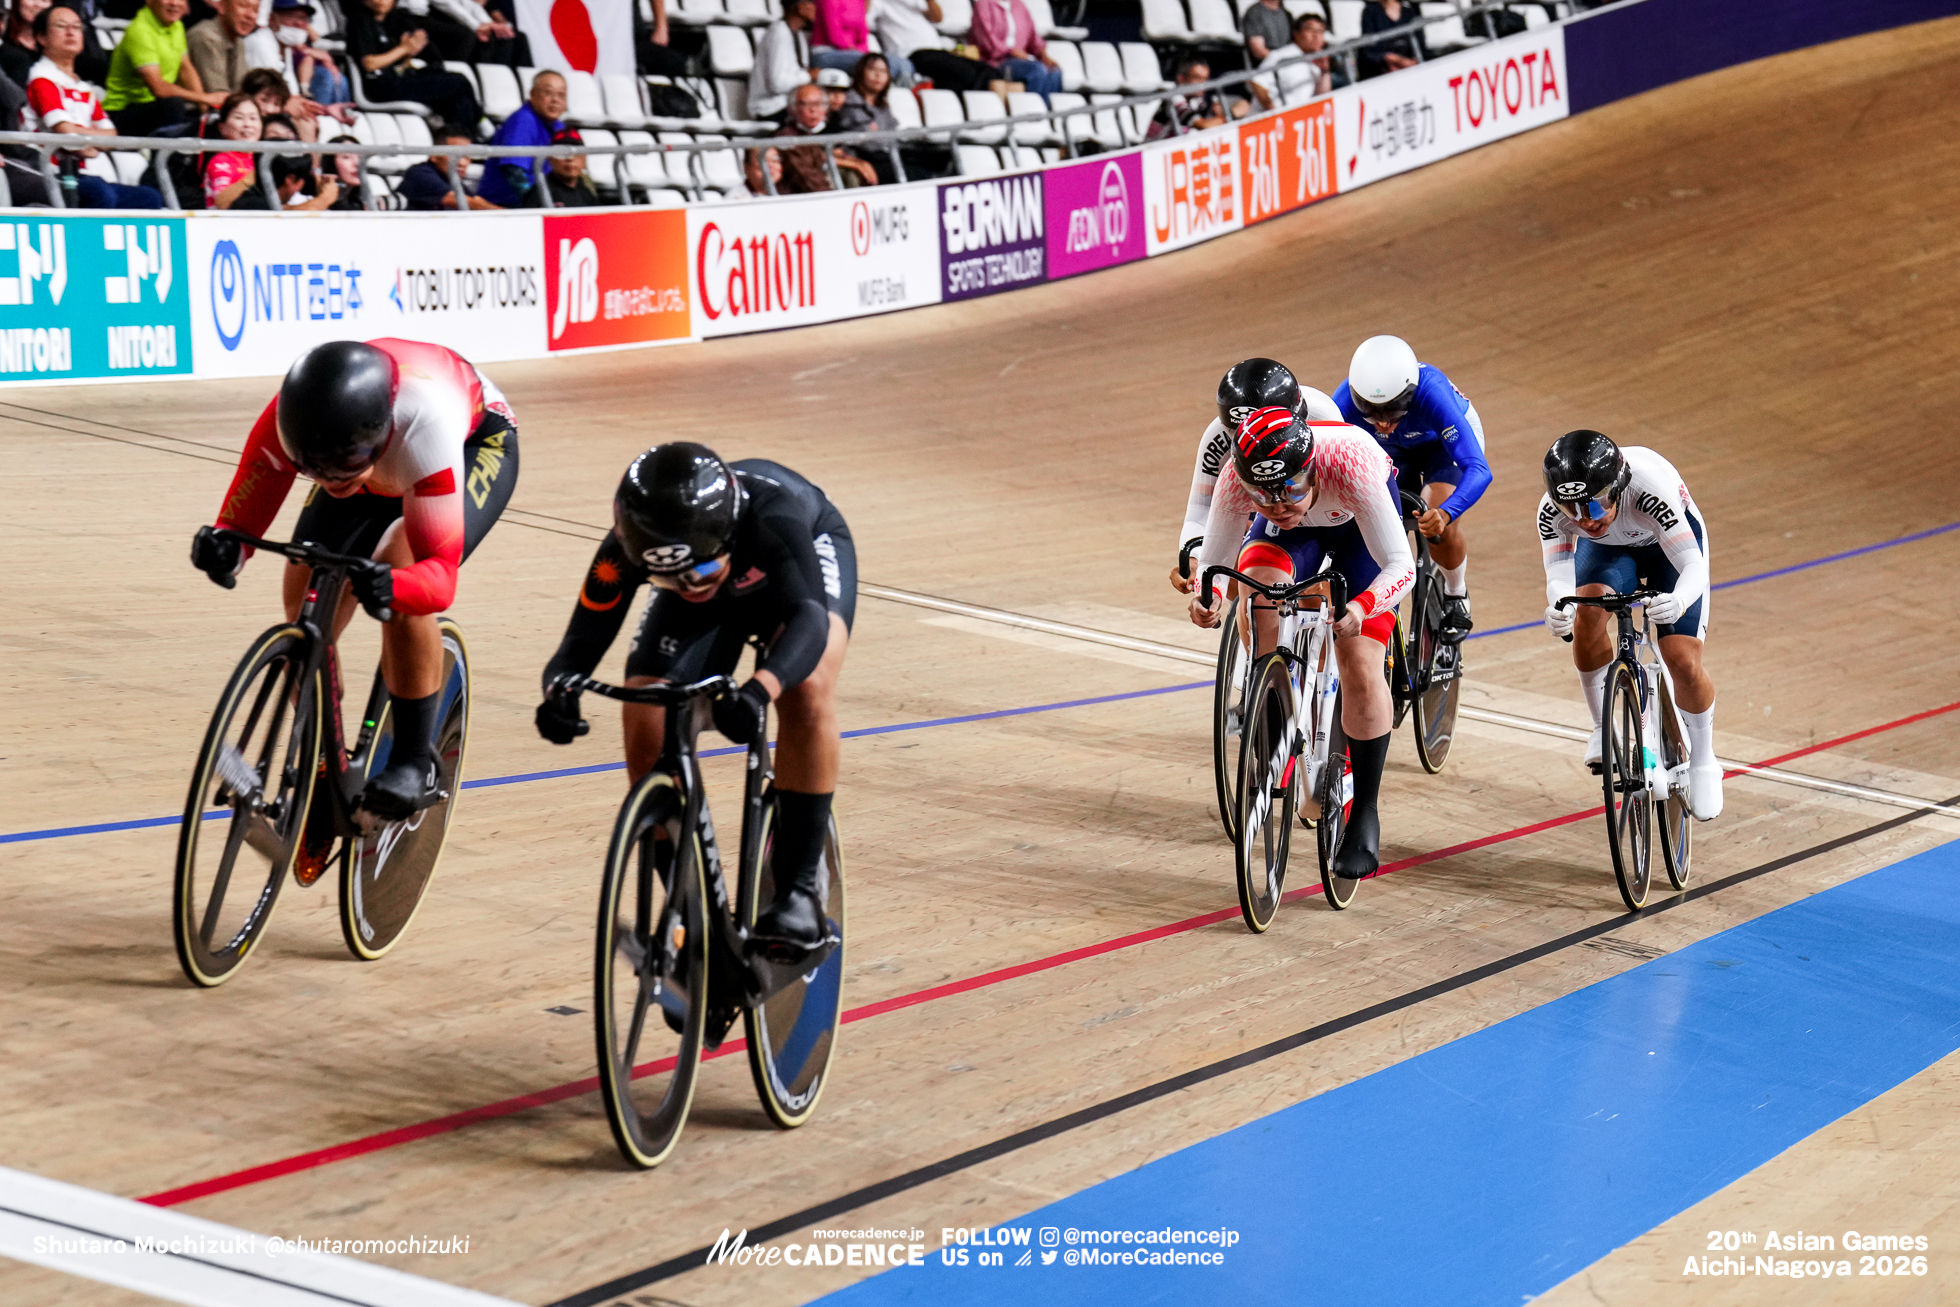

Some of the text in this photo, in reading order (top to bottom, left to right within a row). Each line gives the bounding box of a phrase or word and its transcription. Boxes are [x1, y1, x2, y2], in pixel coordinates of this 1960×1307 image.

[1448, 48, 1559, 133] TOYOTA
[1370, 96, 1435, 162] 中部電力
[942, 174, 1043, 255] BORNAN
[1154, 137, 1233, 244] JR東海
[872, 205, 909, 246] MUFG
[102, 224, 173, 304] ニトリ
[254, 260, 363, 322] NTT西日本
[406, 265, 538, 312] TOBU TOP TOURS
[552, 237, 599, 340] JTB
[697, 221, 816, 320] Canon
[947, 246, 1044, 294] SPORTS TECHNOLOGY
[1, 327, 72, 373] NITORI
[107, 325, 177, 369] NITORI
[220, 460, 268, 520] CHINA
[467, 430, 508, 510] CHINA
[1253, 472, 1287, 481] Kabuto
[1538, 501, 1562, 541] KORE
[1635, 491, 1679, 532] KOREA
[1384, 569, 1415, 600] JAPAN
